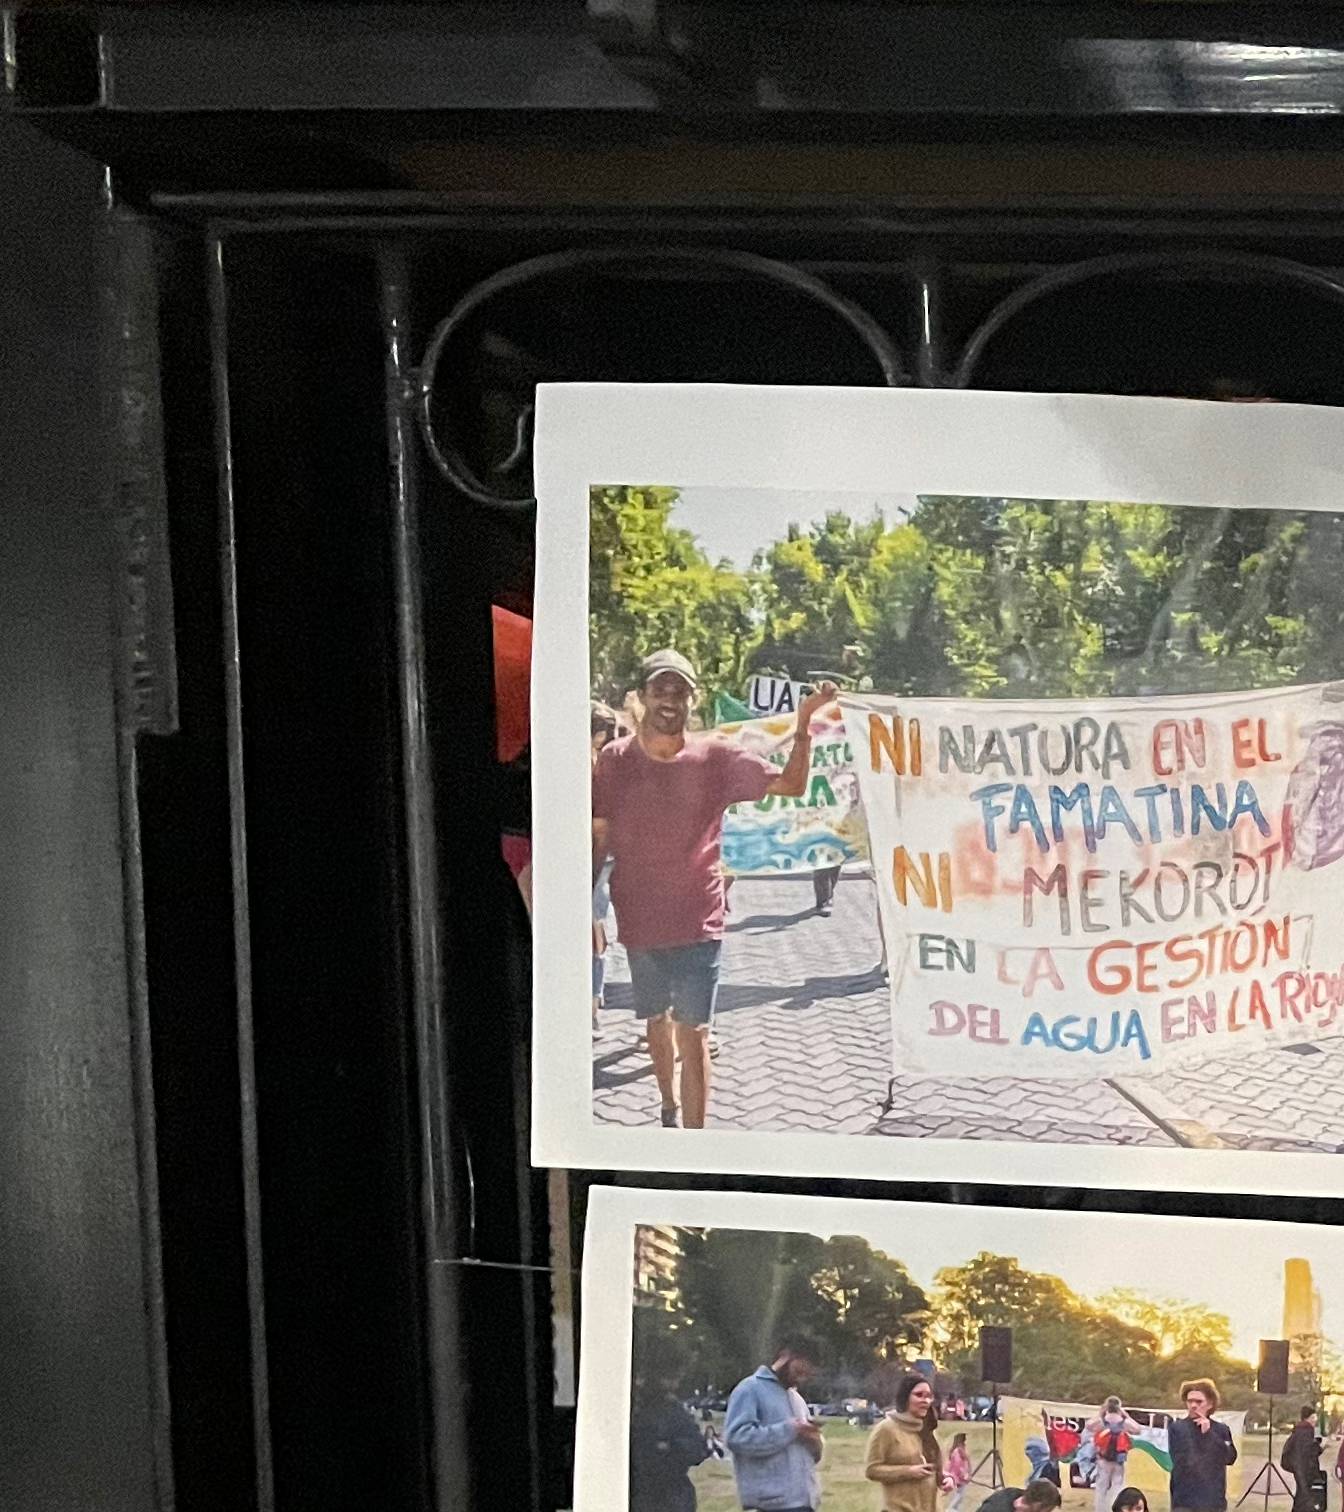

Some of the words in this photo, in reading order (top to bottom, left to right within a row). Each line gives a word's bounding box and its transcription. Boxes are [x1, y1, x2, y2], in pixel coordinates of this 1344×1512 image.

[867, 713, 922, 777] NI
[938, 715, 1131, 779] NATURA
[1152, 716, 1206, 776] EN
[1230, 717, 1282, 770] EL
[968, 780, 1272, 854] FAMATINA
[892, 844, 954, 913] NI
[1022, 844, 1284, 936] MEKOROT
[918, 932, 976, 974] EN
[997, 947, 1065, 998] LA
[927, 1000, 1010, 1046] DEL
[1020, 1009, 1152, 1061] AGUA
[1160, 990, 1217, 1045] EN
[1227, 979, 1274, 1033] LA
